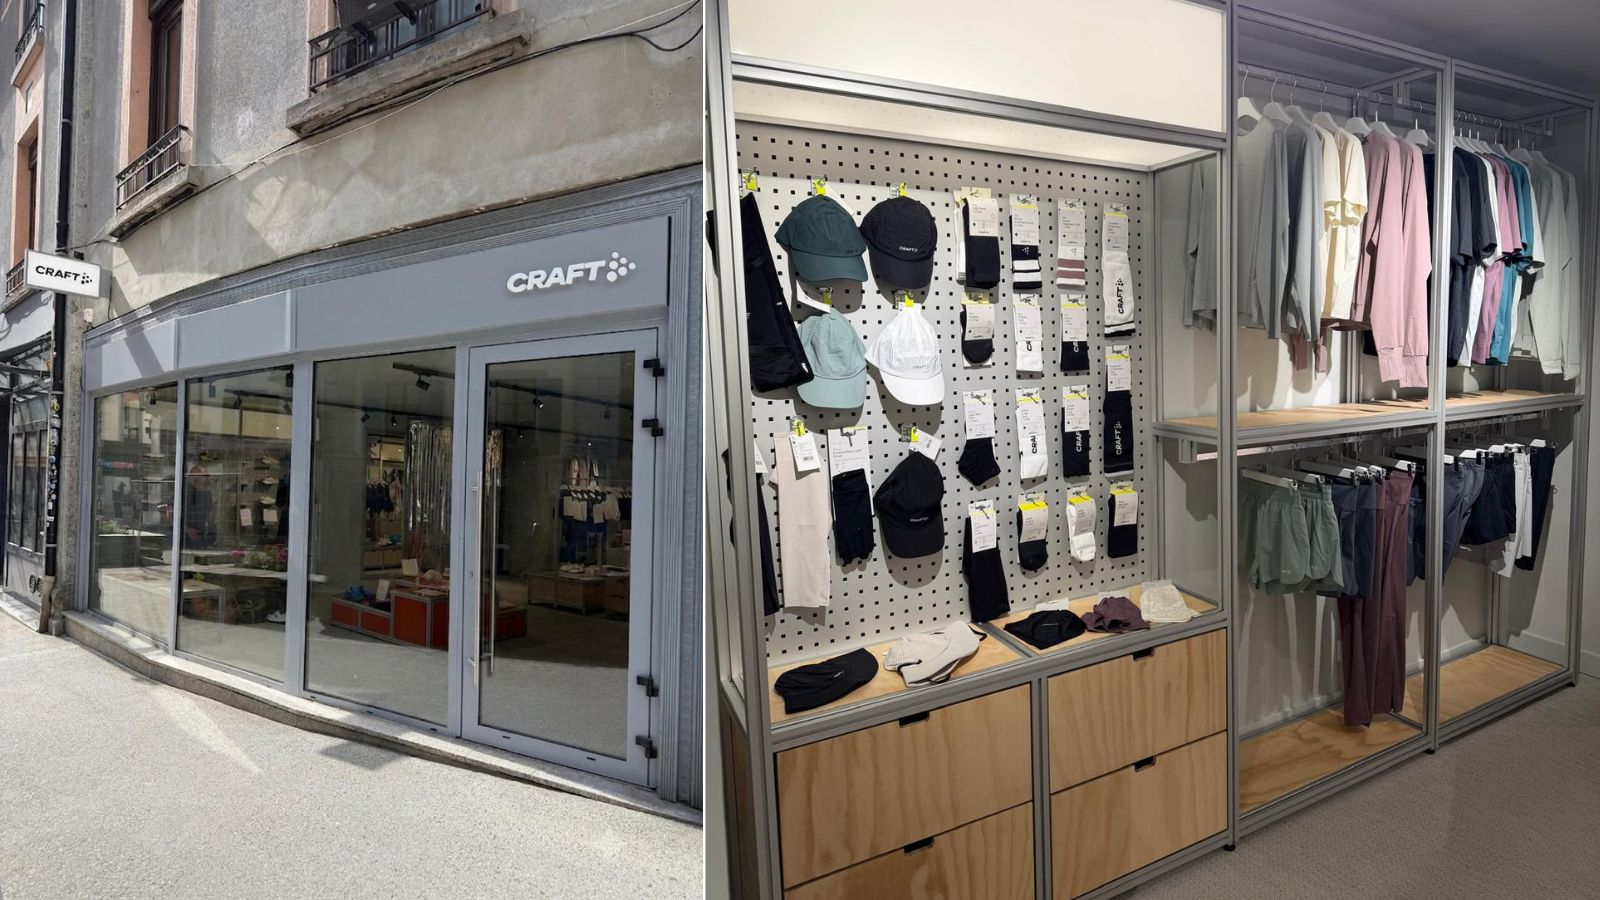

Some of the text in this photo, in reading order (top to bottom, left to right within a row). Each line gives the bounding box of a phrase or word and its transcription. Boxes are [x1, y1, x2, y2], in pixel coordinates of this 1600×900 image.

[35, 265, 80, 281] CRAFT
[506, 260, 606, 293] CRAFT
[1116, 286, 1124, 314] CRAFT
